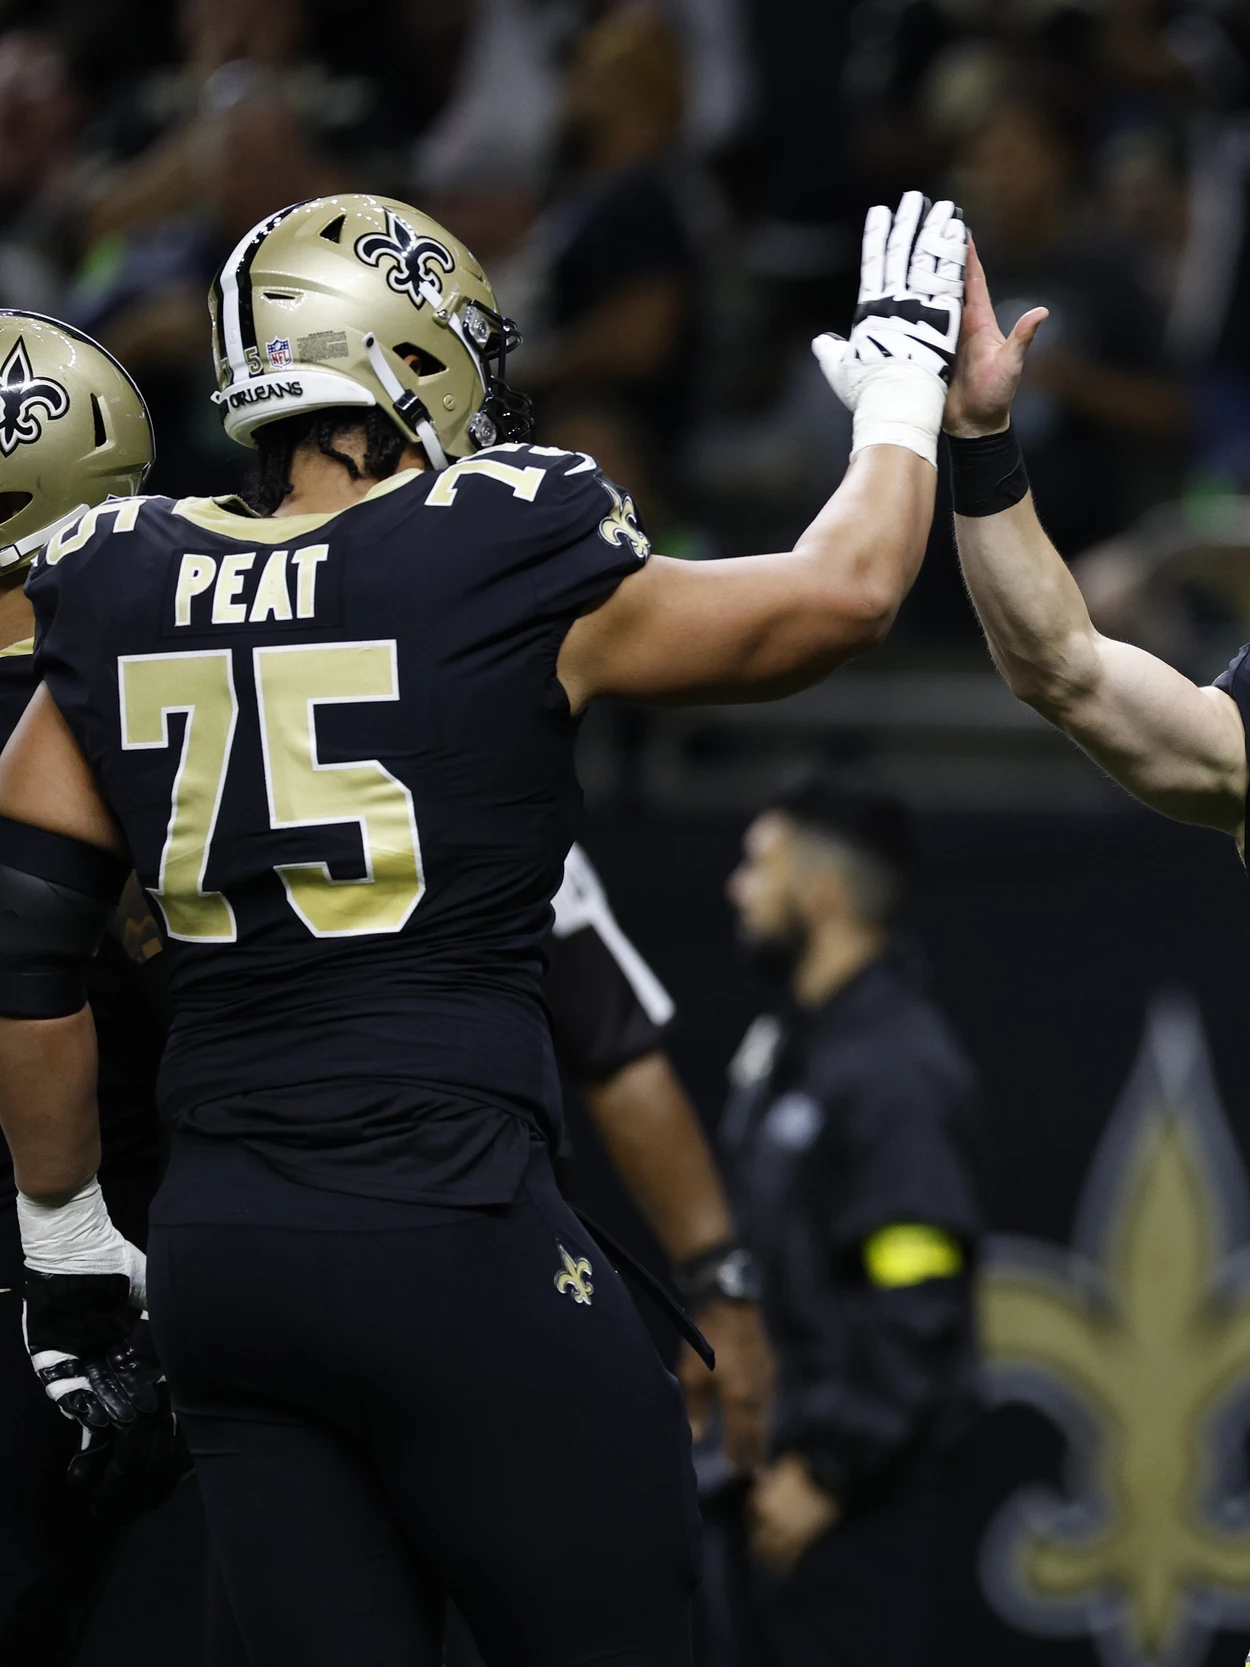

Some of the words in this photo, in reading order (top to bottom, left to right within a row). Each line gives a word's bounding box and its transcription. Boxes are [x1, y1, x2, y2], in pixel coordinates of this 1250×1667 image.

[270, 352, 291, 365] NFL
[229, 381, 303, 408] ORLEANS
[174, 544, 329, 627] PEAT
[117, 639, 426, 942] 75
